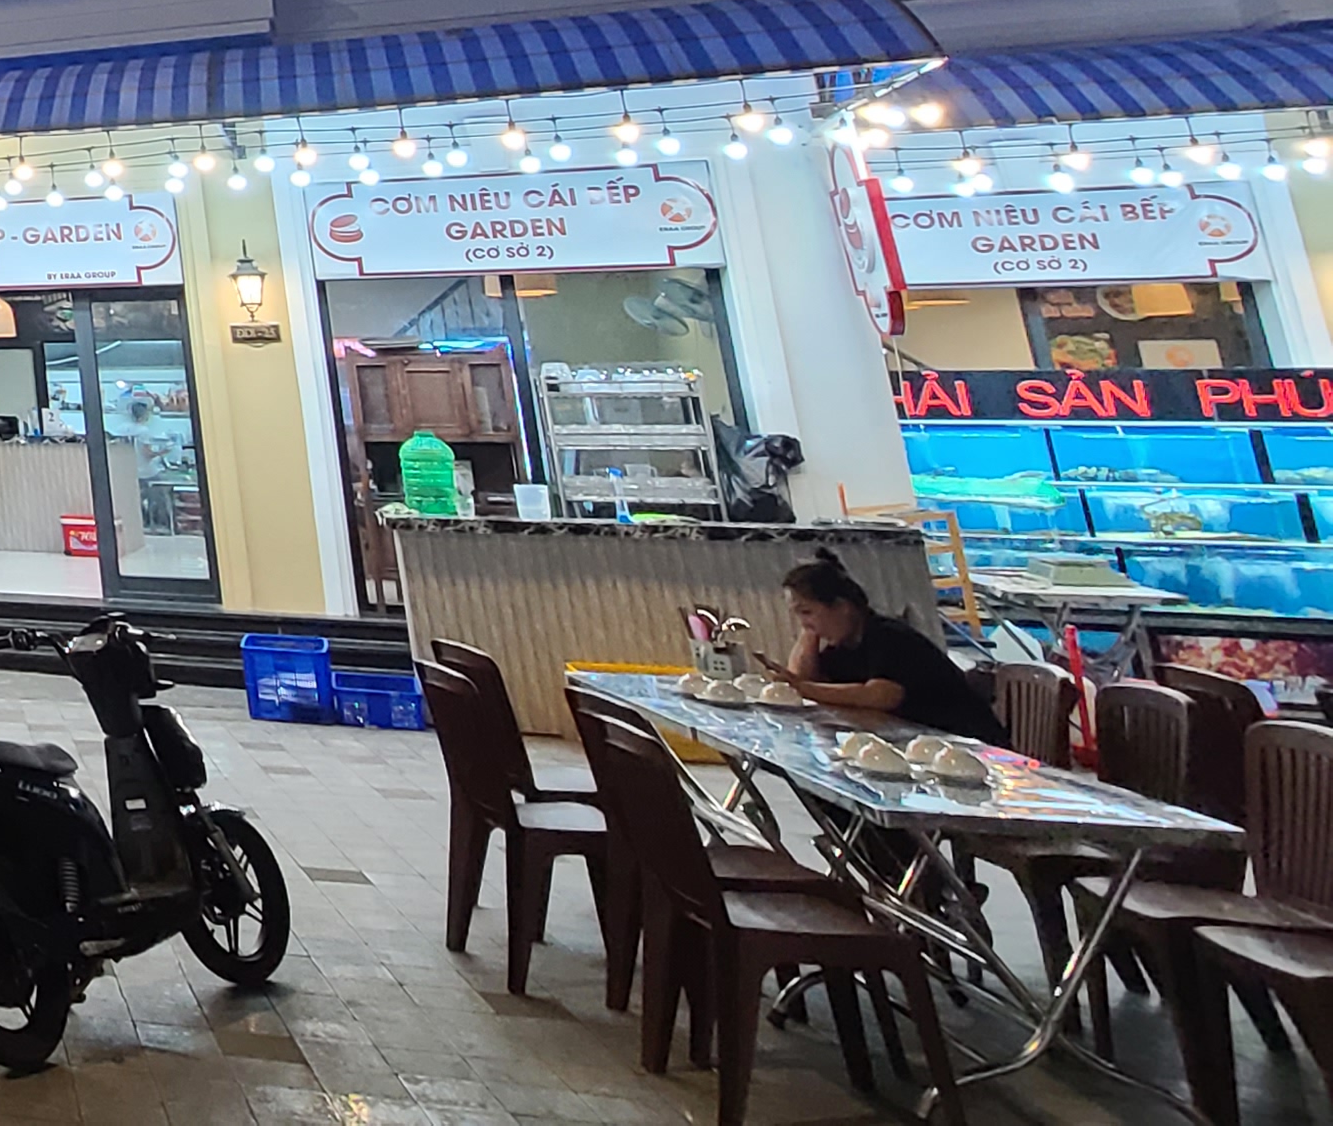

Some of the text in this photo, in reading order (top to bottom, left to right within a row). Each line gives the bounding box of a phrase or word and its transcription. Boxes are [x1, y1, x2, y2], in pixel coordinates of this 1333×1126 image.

[369, 177, 641, 215] CƠM NIÊU CÁI BẾP
[890, 209, 963, 230] CƠM
[972, 204, 1040, 227] NIÊU
[1051, 201, 1109, 224] CÁI
[22, 222, 123, 245] GARDEN
[445, 216, 568, 240] GARDEN
[465, 242, 554, 263] (CƠ SỞ 2)
[970, 232, 1100, 254] GARDEN
[46, 272, 57, 280] BY
[84, 271, 117, 279] GROUP
[993, 255, 1088, 274] (CƠ SỞ 2)
[1015, 368, 1152, 418] SẢN
